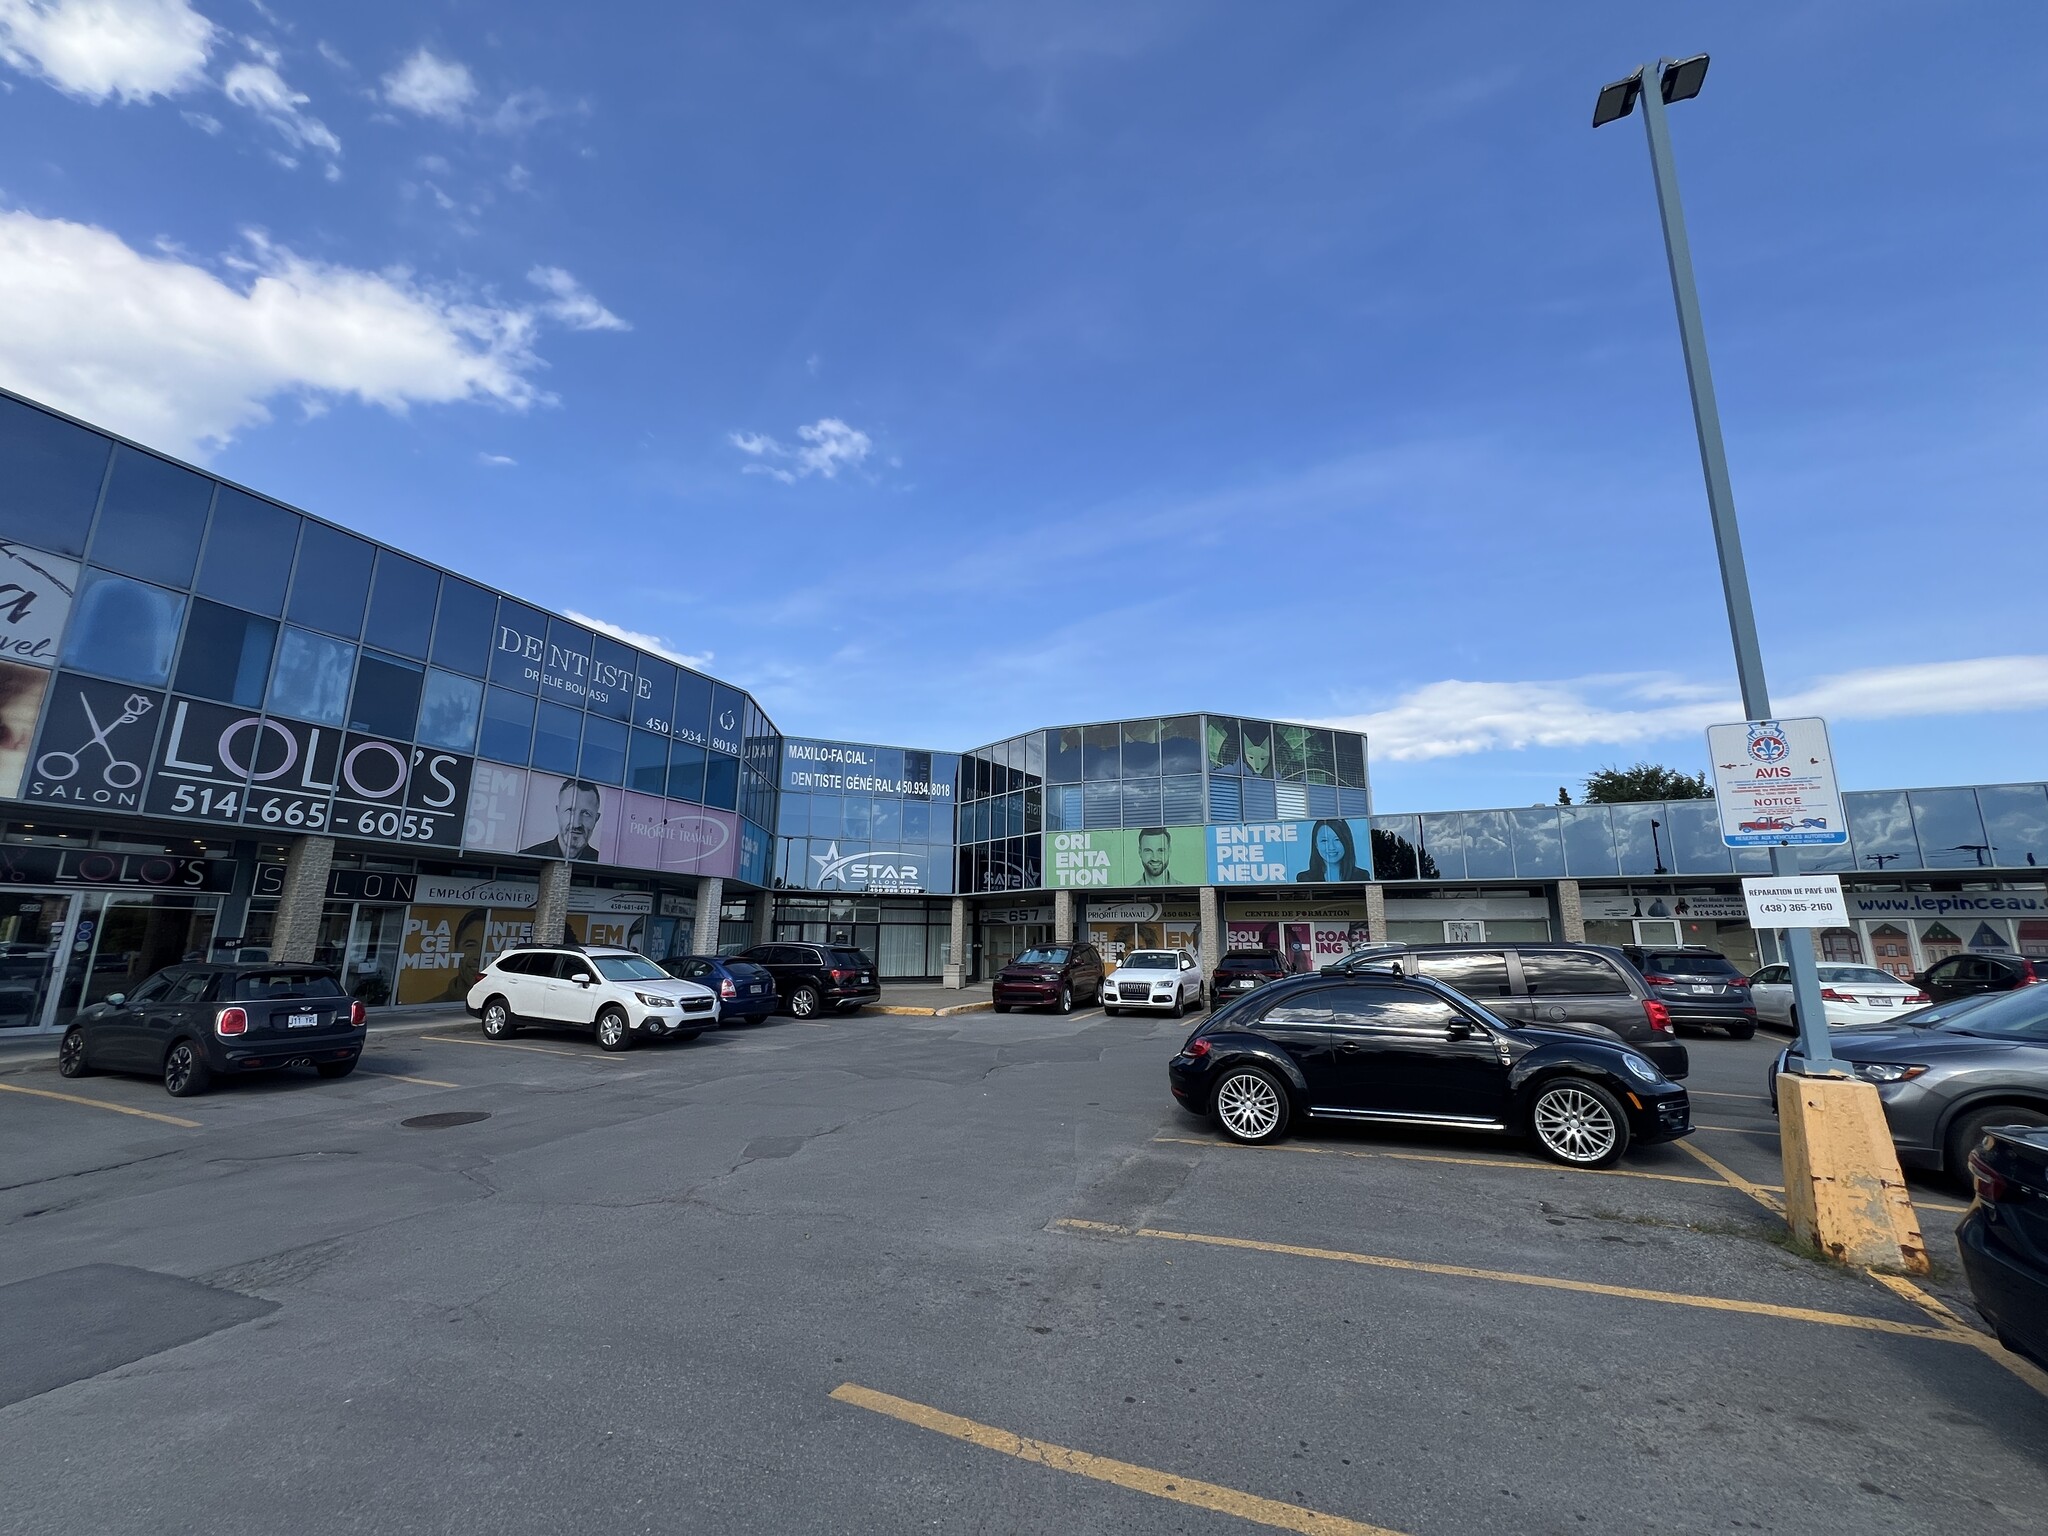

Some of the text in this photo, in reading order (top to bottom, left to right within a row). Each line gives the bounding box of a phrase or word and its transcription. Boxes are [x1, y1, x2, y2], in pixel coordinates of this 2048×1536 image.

[498, 626, 652, 700] DENTISTE
[524, 668, 540, 682] DR
[543, 674, 563, 689] ELIE
[646, 718, 669, 733] 450
[712, 737, 738, 754] 8018
[164, 701, 458, 808] LOLO'S
[1755, 766, 1792, 778] AVIS
[473, 767, 519, 797] EM
[791, 771, 842, 789] DENTISTE
[846, 773, 894, 793] GÉNÉRAL
[895, 780, 951, 797] 450.934.8018
[31, 782, 137, 806] SALON
[1754, 796, 1803, 807] NOTICE
[469, 792, 506, 820] PL
[465, 818, 497, 845] OI
[630, 822, 714, 847] PRIORITÉ TRAVAIL
[1215, 824, 1298, 844] ENTRE
[1054, 833, 1091, 850] ORI
[1056, 850, 1111, 868] ENTA
[1216, 845, 1265, 863] PRE
[55, 851, 206, 886] LOLO'S
[850, 864, 919, 881] STAR
[1056, 868, 1108, 886] TION
[1217, 864, 1287, 882] NEUR
[261, 867, 414, 899] SLON
[1748, 887, 1793, 897] RÉPARATION
[1794, 887, 1803, 895] DE
[1804, 886, 1823, 895] PAVÉ
[429, 887, 532, 903] EMPLOI GAGNIER
[1008, 909, 1040, 922] 657
[1295, 909, 1350, 917] FORMATION
[1759, 902, 1834, 914] (438) 365-2160
[407, 919, 452, 937] PLA
[487, 921, 534, 937] INTE
[590, 924, 625, 945] EM
[1090, 931, 1108, 942] RE
[1228, 930, 1260, 942] SOU
[1315, 930, 1371, 943] COACH
[420, 936, 452, 953] CE
[1167, 931, 1195, 948] EM
[1316, 943, 1344, 954] ING
[400, 952, 465, 970] MENT
